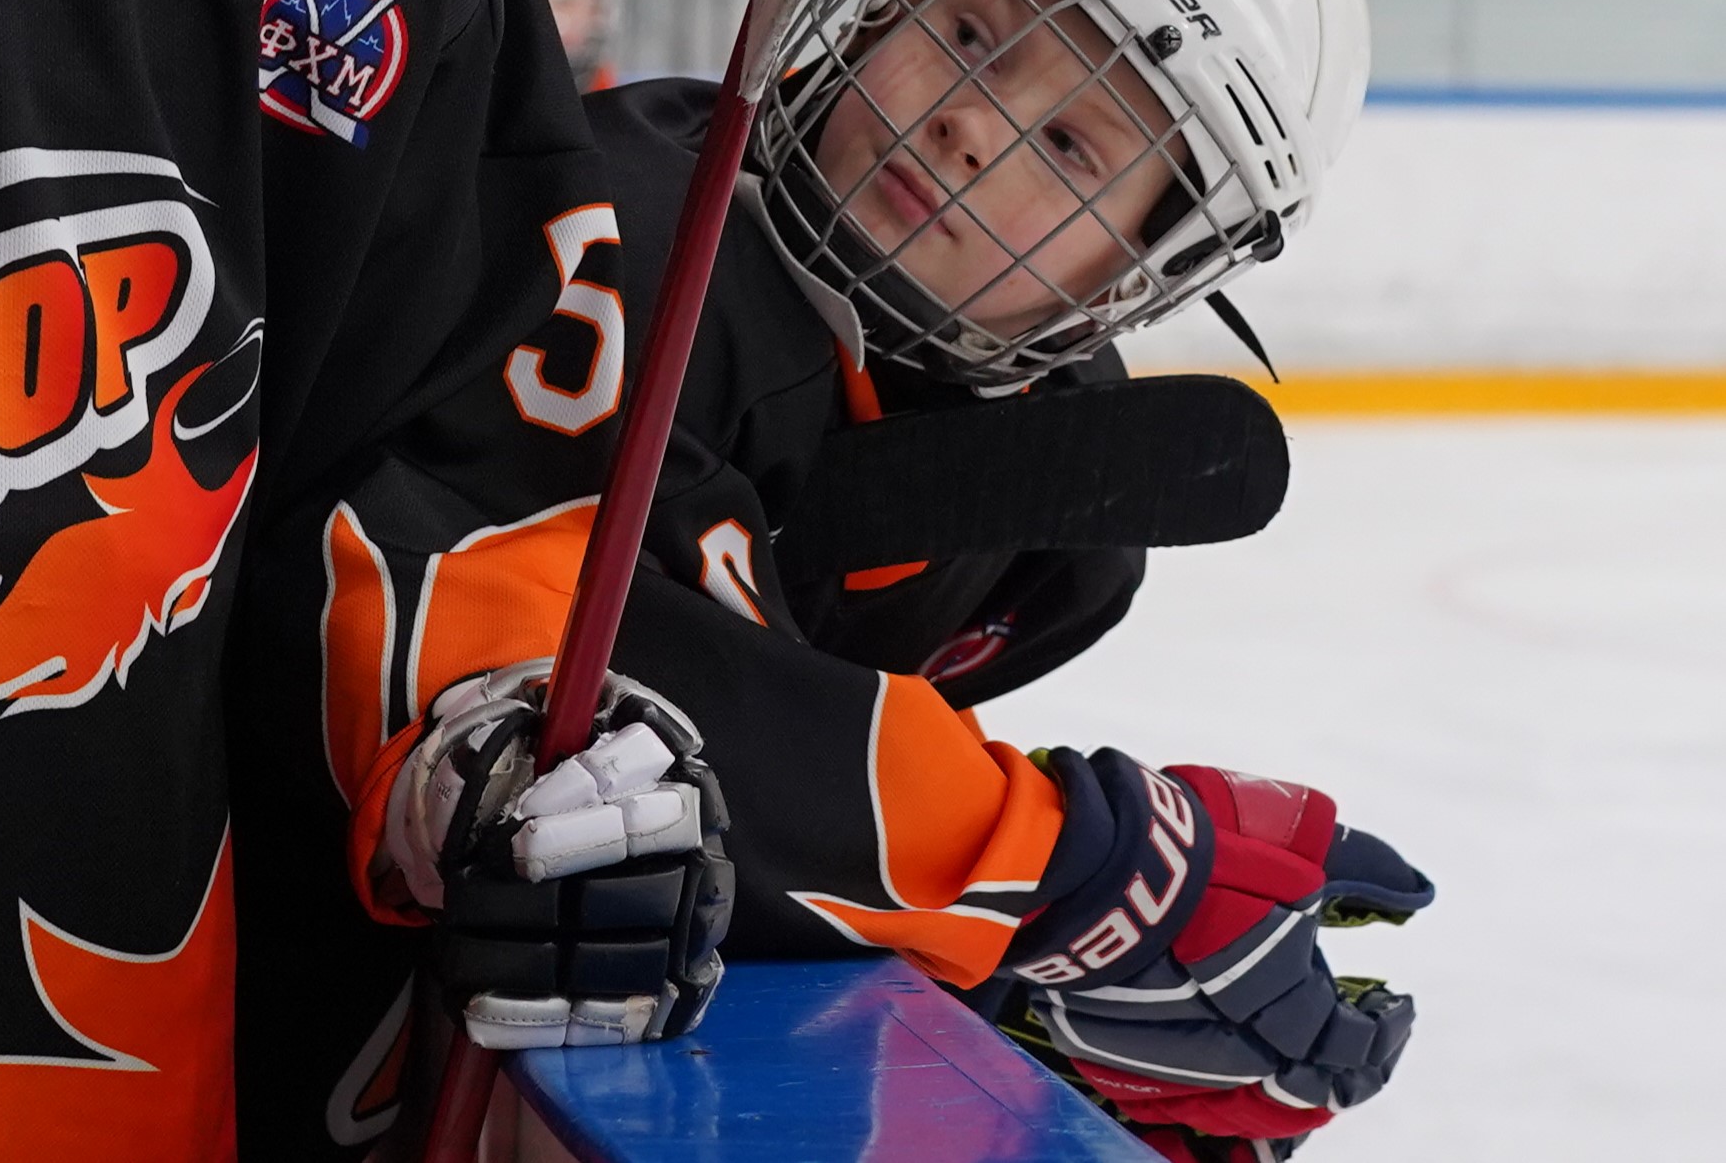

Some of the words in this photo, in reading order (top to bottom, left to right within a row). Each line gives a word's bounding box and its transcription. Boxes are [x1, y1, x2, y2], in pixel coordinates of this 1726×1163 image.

[259, 17, 375, 107] ФХМ
[503, 201, 625, 437] 5
[1012, 756, 1196, 985] BAUE
